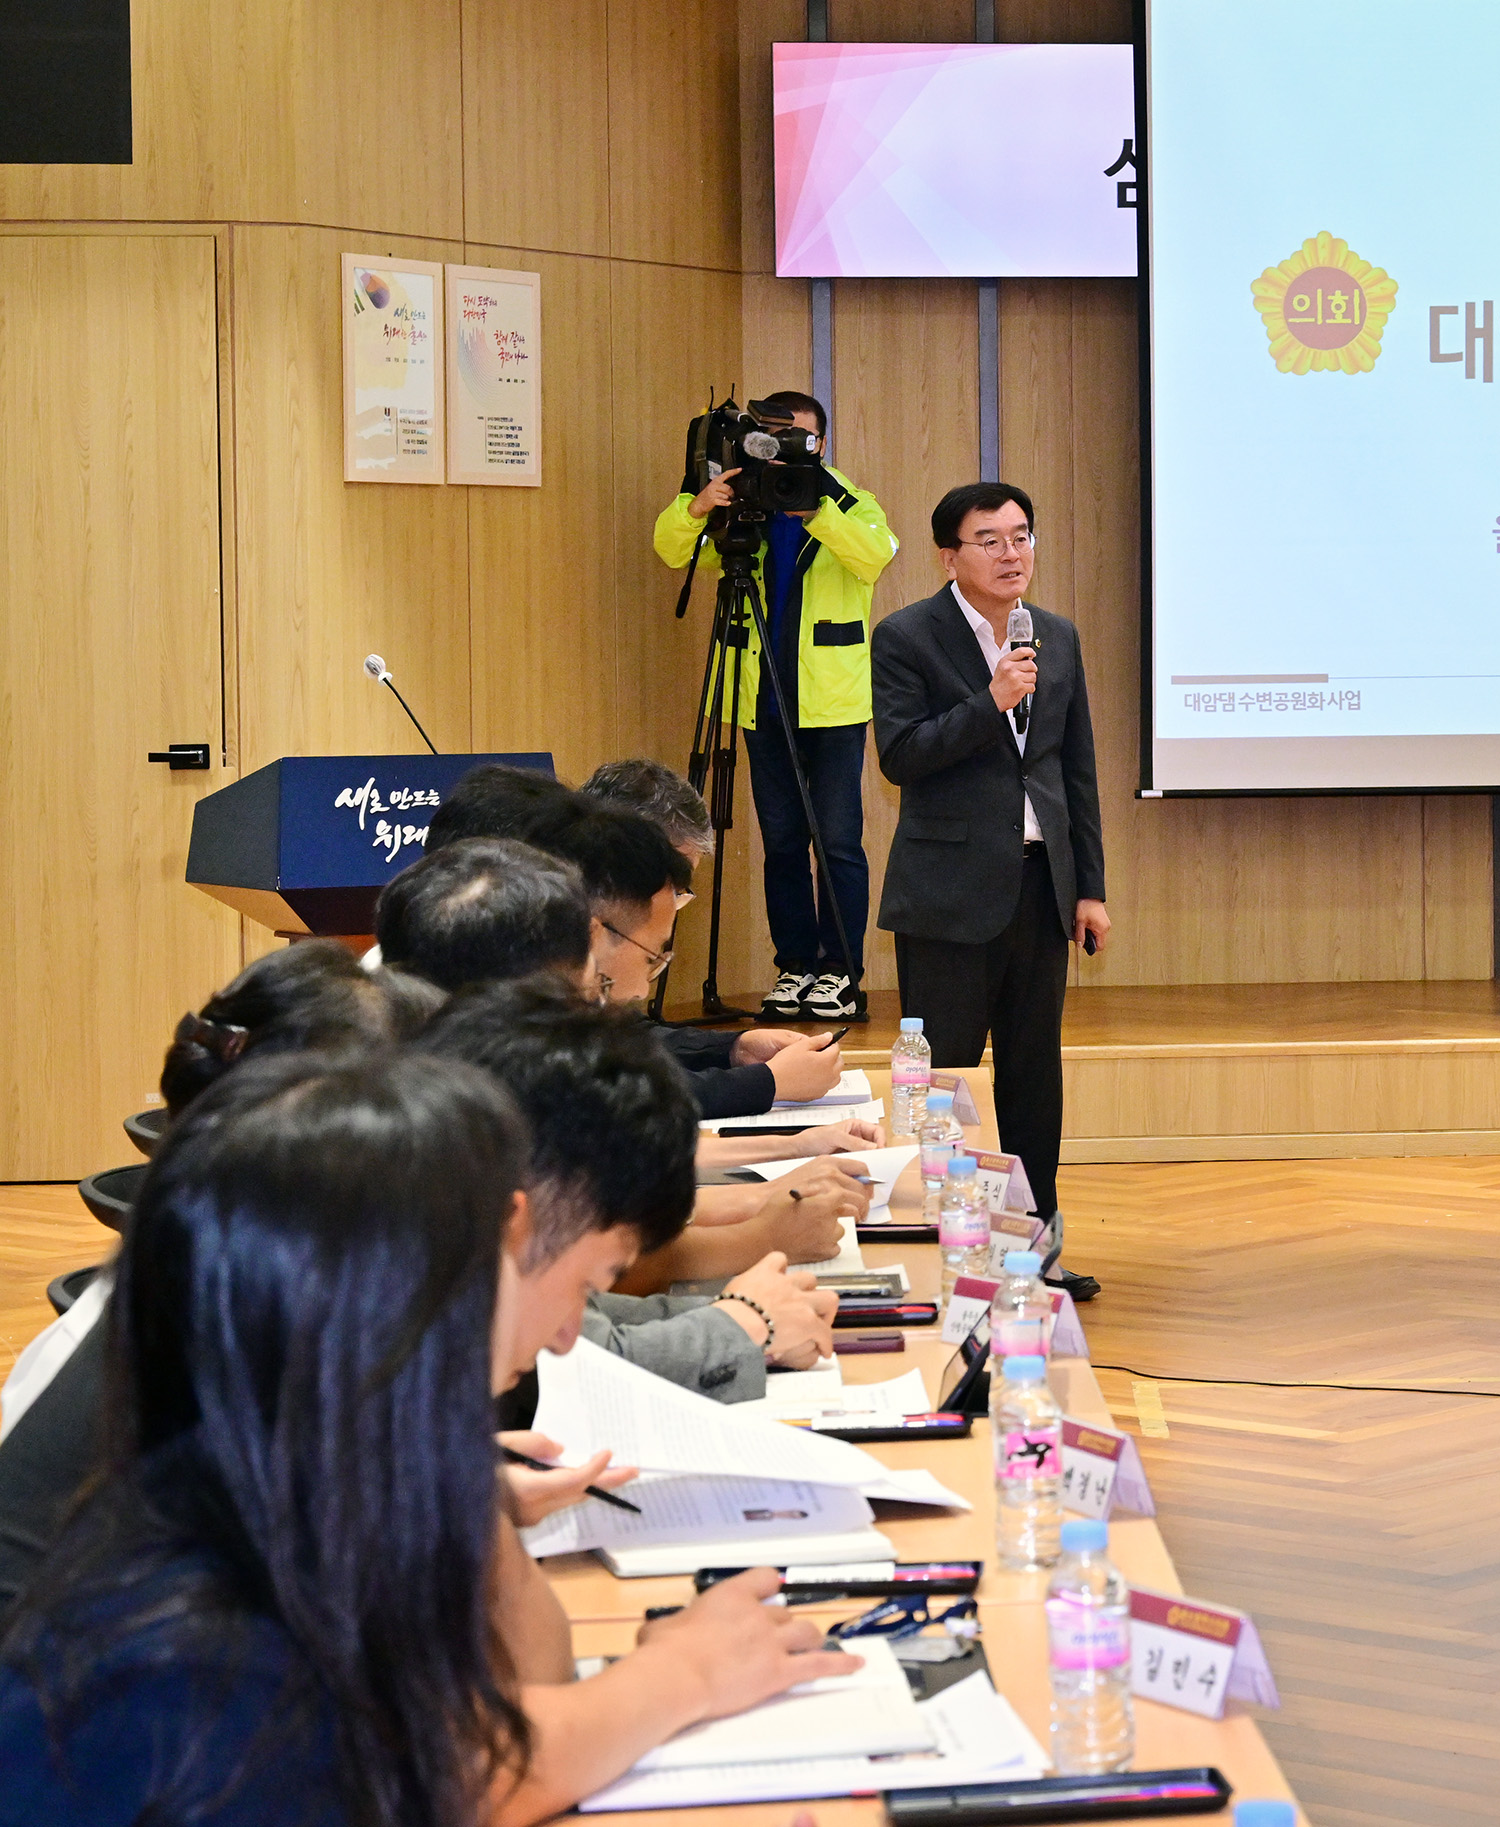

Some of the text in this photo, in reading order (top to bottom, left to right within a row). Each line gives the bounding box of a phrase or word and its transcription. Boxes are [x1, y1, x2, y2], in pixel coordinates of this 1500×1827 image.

[1288, 288, 1361, 326] 의회
[1184, 690, 1362, 713] 대암댐 수변공원화 사업
[334, 776, 440, 831] 새로 만드는
